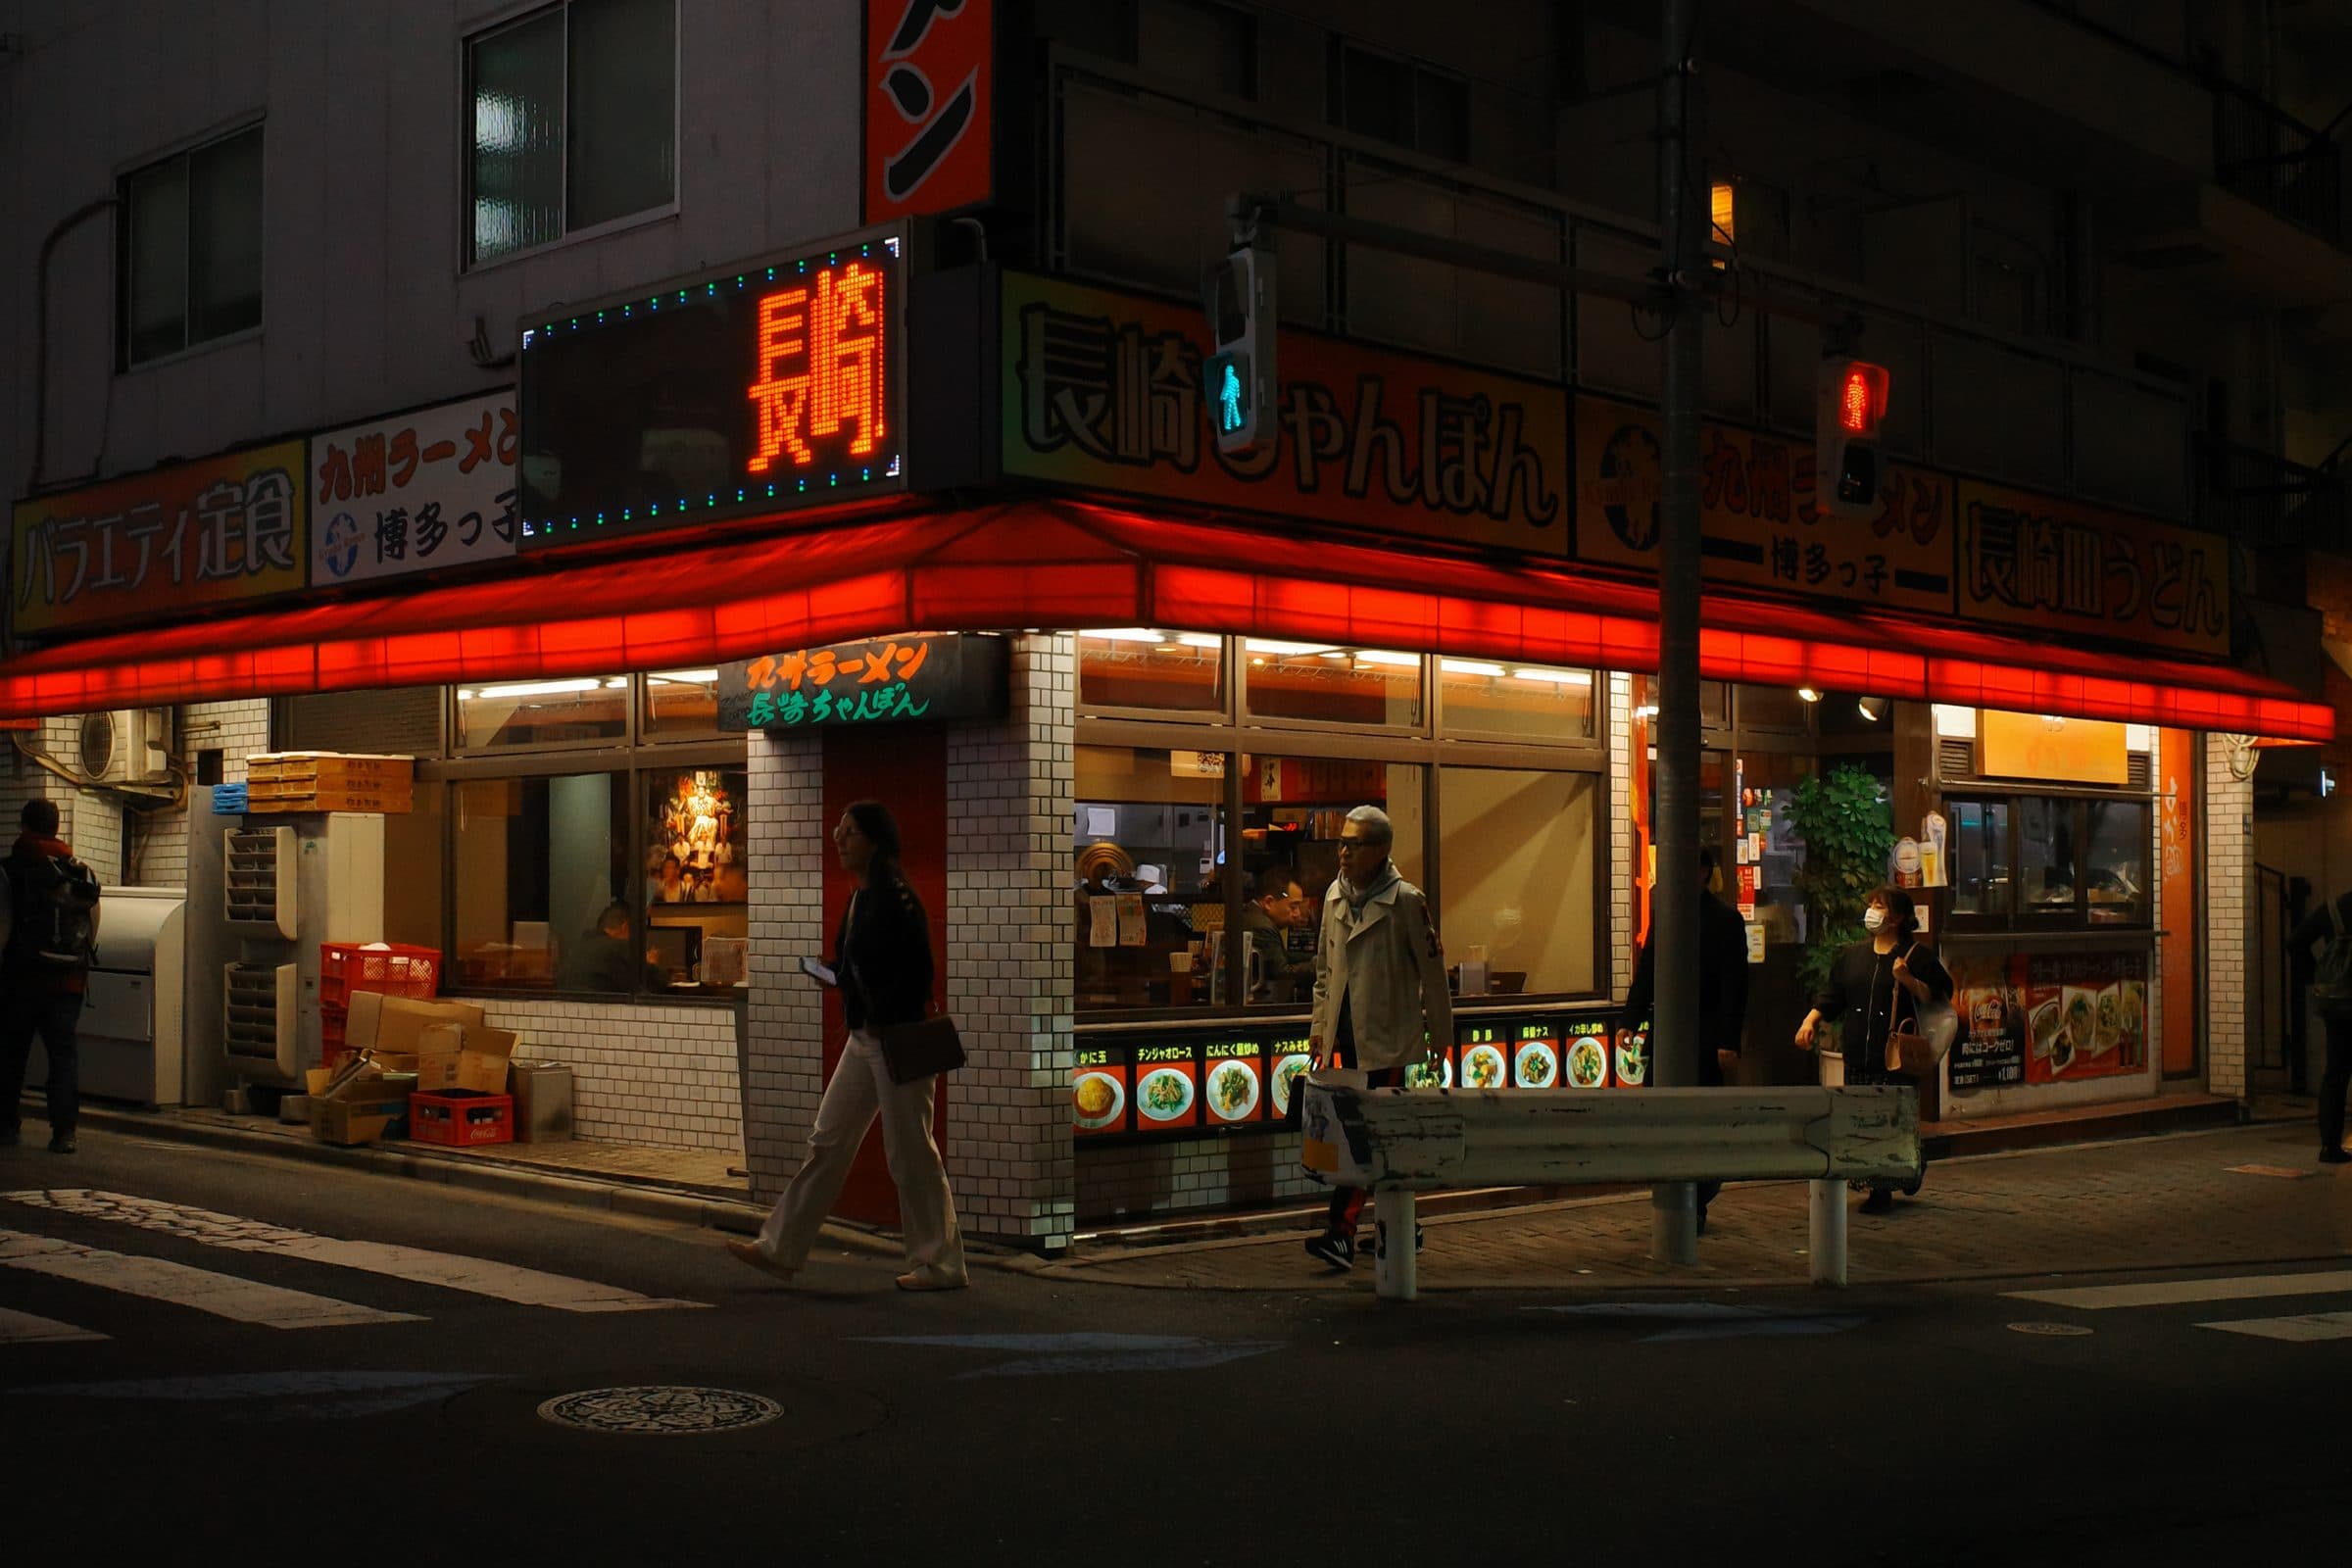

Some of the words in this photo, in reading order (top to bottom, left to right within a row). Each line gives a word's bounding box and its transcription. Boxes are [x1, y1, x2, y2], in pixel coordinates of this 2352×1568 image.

[747, 262, 885, 474] 長崎
[19, 466, 295, 612] バラエティ定食
[1771, 534, 1891, 595] 博多っ子
[1965, 501, 2225, 638] 長崎皿うどん
[747, 682, 930, 727] 長崎ちゃんぽん
[1079, 1050, 1107, 1064] かに玉
[1137, 1047, 1193, 1061] チンジャオロース
